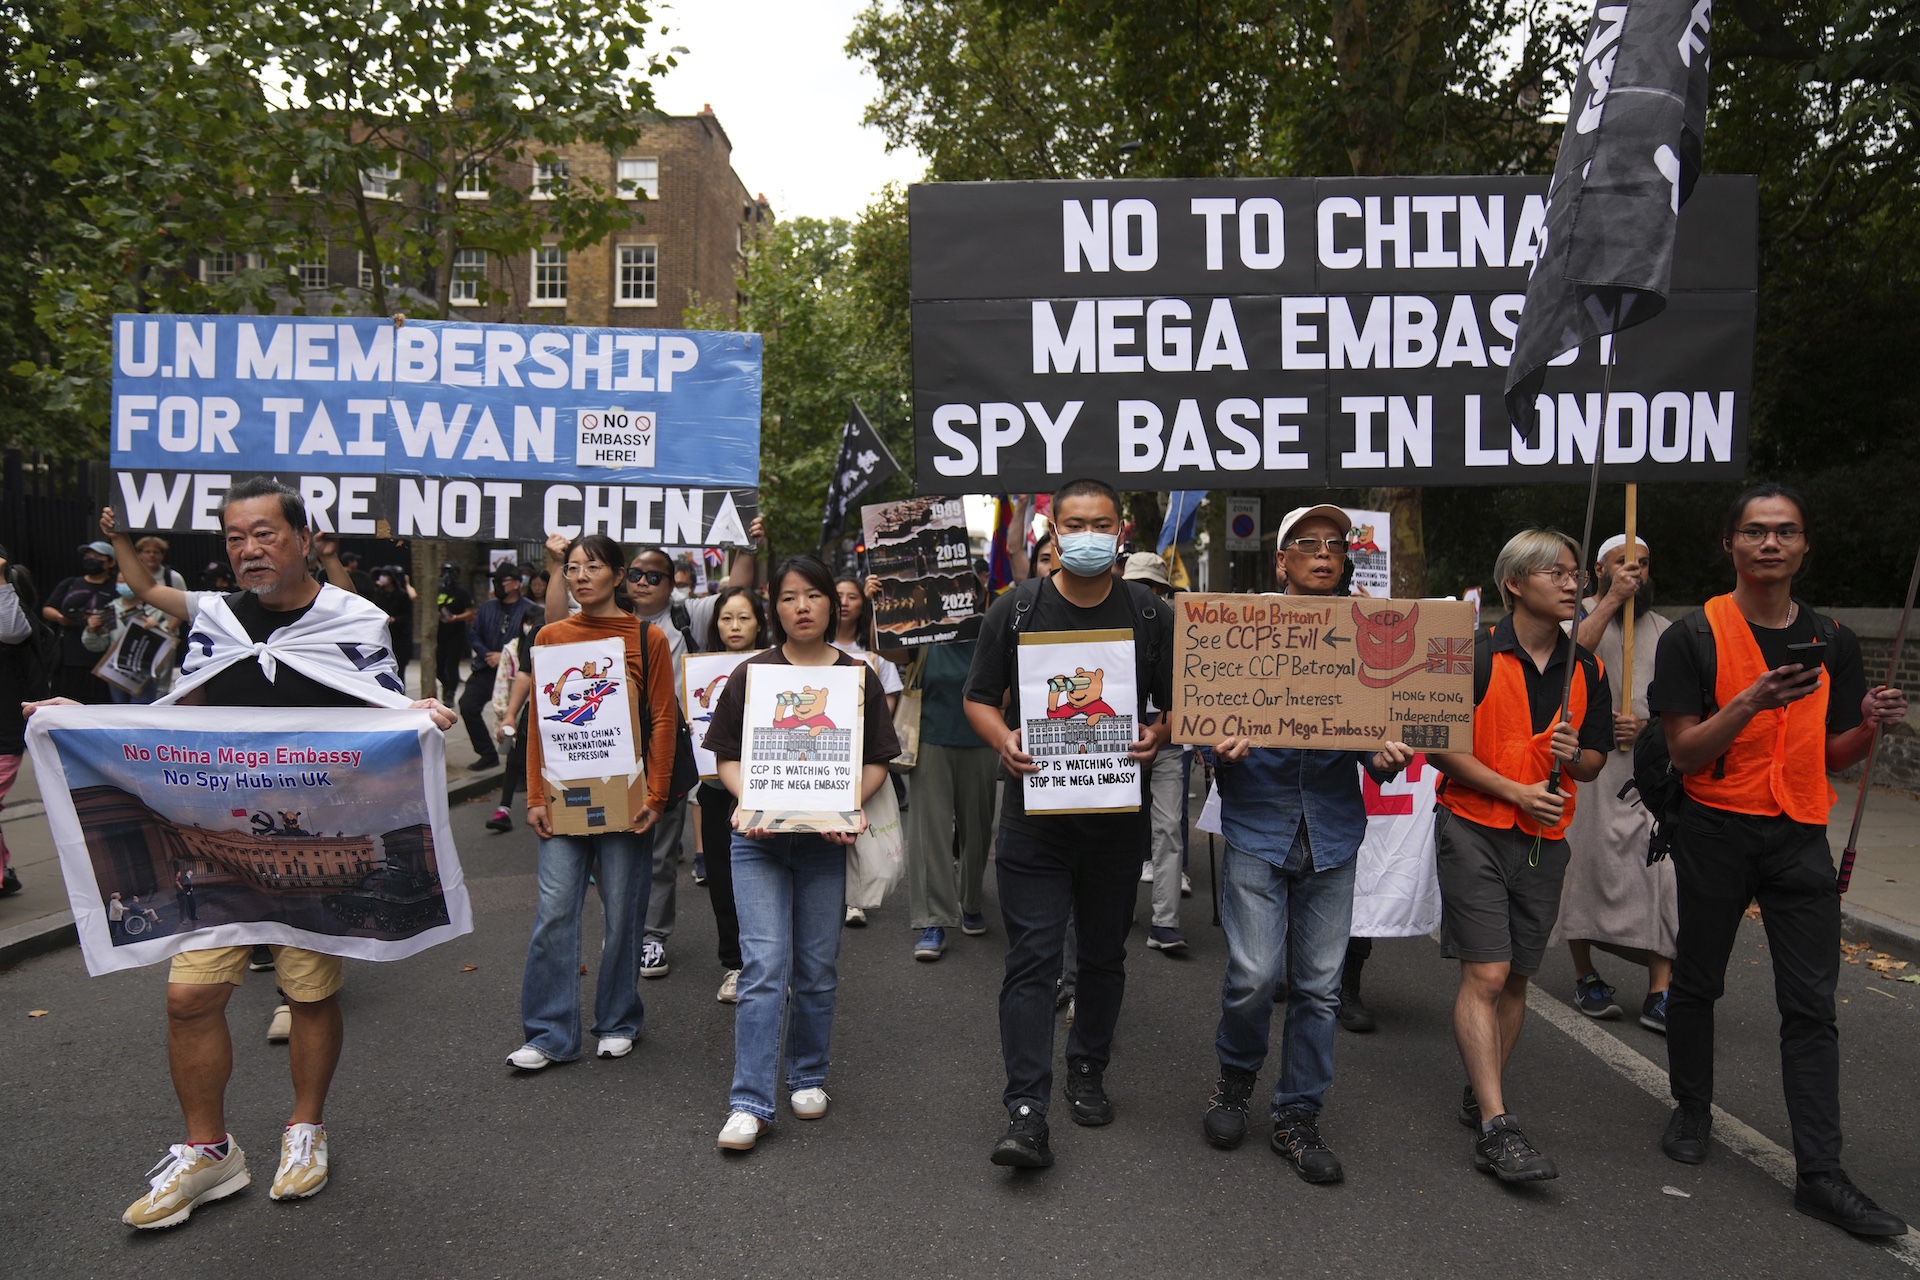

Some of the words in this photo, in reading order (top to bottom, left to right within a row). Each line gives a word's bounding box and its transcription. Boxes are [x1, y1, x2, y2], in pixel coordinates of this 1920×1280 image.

[1063, 199, 1158, 273] NO
[1191, 197, 1285, 271] TO
[1317, 195, 1545, 269] CHINA
[1032, 298, 1249, 374] MEGA
[119, 320, 217, 379] U.N
[236, 322, 699, 393] MEMBERSHIP
[117, 395, 240, 454] FOR
[262, 397, 556, 463] TAIWAN
[604, 414, 628, 428] NO
[582, 432, 651, 446] EMBASSY
[932, 400, 1085, 477] SPY
[1119, 397, 1309, 473] BASE
[1341, 395, 1433, 469] IN
[1465, 391, 1735, 467] LONDON
[595, 449, 636, 462] HERE!
[116, 471, 232, 531] WE
[271, 475, 377, 536] RE
[398, 478, 522, 539] NOT
[543, 484, 750, 546] CHINA
[930, 501, 961, 519] 1989
[1233, 505, 1254, 513] ZONE
[935, 542, 967, 561] 2019
[941, 592, 973, 611] 2022
[947, 608, 974, 618] Shanghai
[1184, 601, 1238, 625] Wake
[1243, 604, 1266, 628] Up
[1270, 603, 1331, 626] Britain!
[1374, 613, 1400, 627] CCP
[1186, 624, 1221, 650] See
[1226, 625, 1282, 651] CCP's
[1287, 626, 1318, 650] Evil
[1184, 653, 1243, 682] Reject
[1249, 653, 1289, 677] CCP
[1292, 655, 1355, 679] Betrayal
[1184, 684, 1250, 708] Protect
[1252, 688, 1283, 707] Our
[1286, 687, 1343, 707] Interest
[1392, 691, 1426, 702] HONG
[1429, 691, 1464, 704] KONG
[1388, 707, 1470, 724] Independence
[552, 734, 565, 742] SAY
[568, 732, 578, 740] NO
[580, 731, 589, 739] TO
[591, 727, 621, 738] CHINA'S
[1180, 714, 1217, 737] NO
[1222, 714, 1272, 737] China
[1278, 717, 1318, 740] Mega
[1321, 717, 1387, 740] Embassy
[558, 739, 616, 752] TRANSNATIONAL
[123, 744, 150, 761] No
[155, 745, 211, 765] China
[217, 746, 269, 768] Mega
[275, 747, 362, 767] Embassy
[568, 750, 609, 761] REPRESSION
[1053, 761, 1062, 771] IS
[1066, 758, 1113, 770] WATCHING
[1117, 758, 1135, 767] YOU
[751, 765, 769, 775] CCP
[773, 765, 781, 775] IS
[786, 765, 830, 776] WATCHING
[834, 766, 850, 776] YOU
[163, 769, 190, 786] No
[196, 771, 229, 791] Spy
[235, 772, 273, 789] Hub
[278, 773, 296, 788] in
[301, 771, 332, 788] UK
[750, 779, 769, 790] STOP
[771, 779, 784, 790] THE
[788, 779, 811, 790] MEGA
[814, 780, 850, 790] EMBASSY
[1030, 776, 1050, 788] STOP
[1052, 776, 1066, 787] THE
[1070, 775, 1094, 786] MEGA
[1098, 773, 1136, 785] EMBASSY
